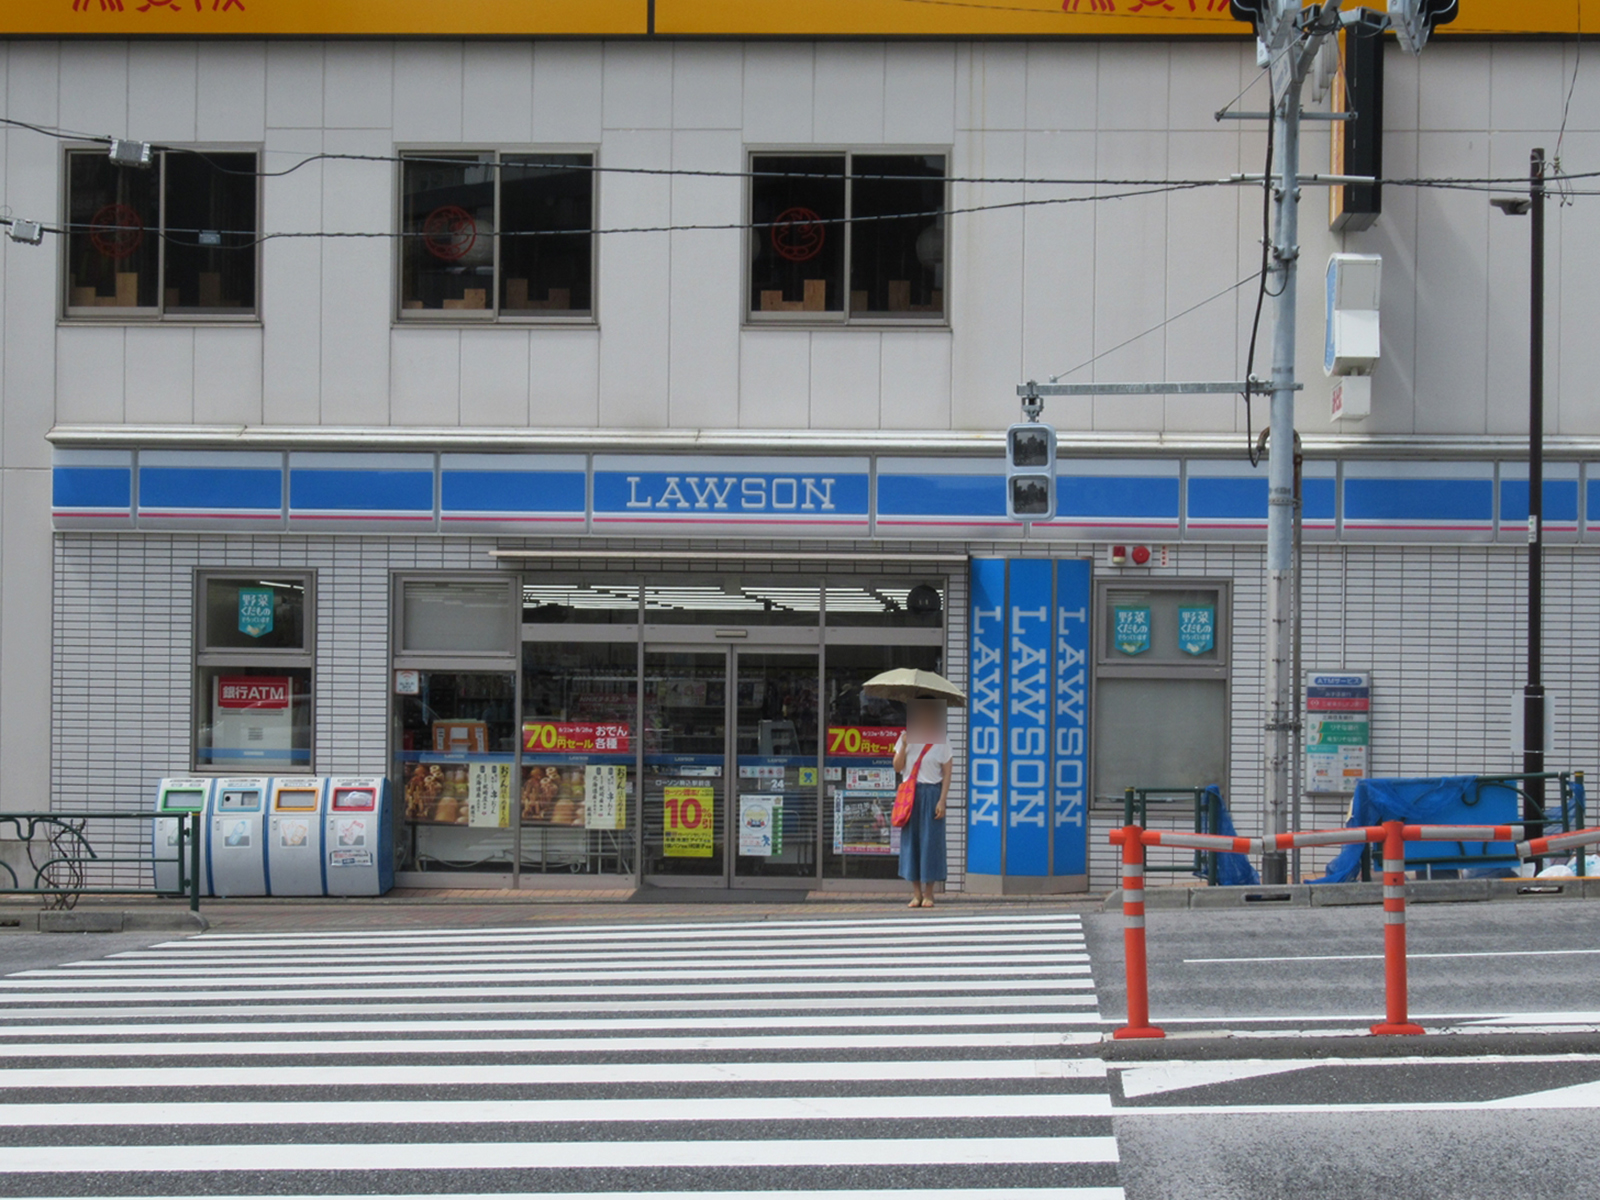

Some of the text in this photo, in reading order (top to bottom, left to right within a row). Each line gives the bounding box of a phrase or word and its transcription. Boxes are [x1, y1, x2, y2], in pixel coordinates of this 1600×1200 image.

[626, 476, 835, 509] LAWSON
[242, 594, 269, 606] 野菜
[241, 606, 271, 616] くだもの
[1118, 611, 1146, 624] 野菜
[1181, 611, 1209, 624] 野菜
[1117, 624, 1148, 634] くだもの
[1180, 624, 1212, 634] くだもの
[222, 686, 284, 699] 銀行ATM
[971, 606, 1001, 827] LAWSON
[1010, 606, 1047, 828] LAWSON
[1054, 606, 1086, 828] LAWSON
[595, 725, 628, 737] おでん
[595, 738, 618, 749] 各種
[771, 779, 785, 789] 24
